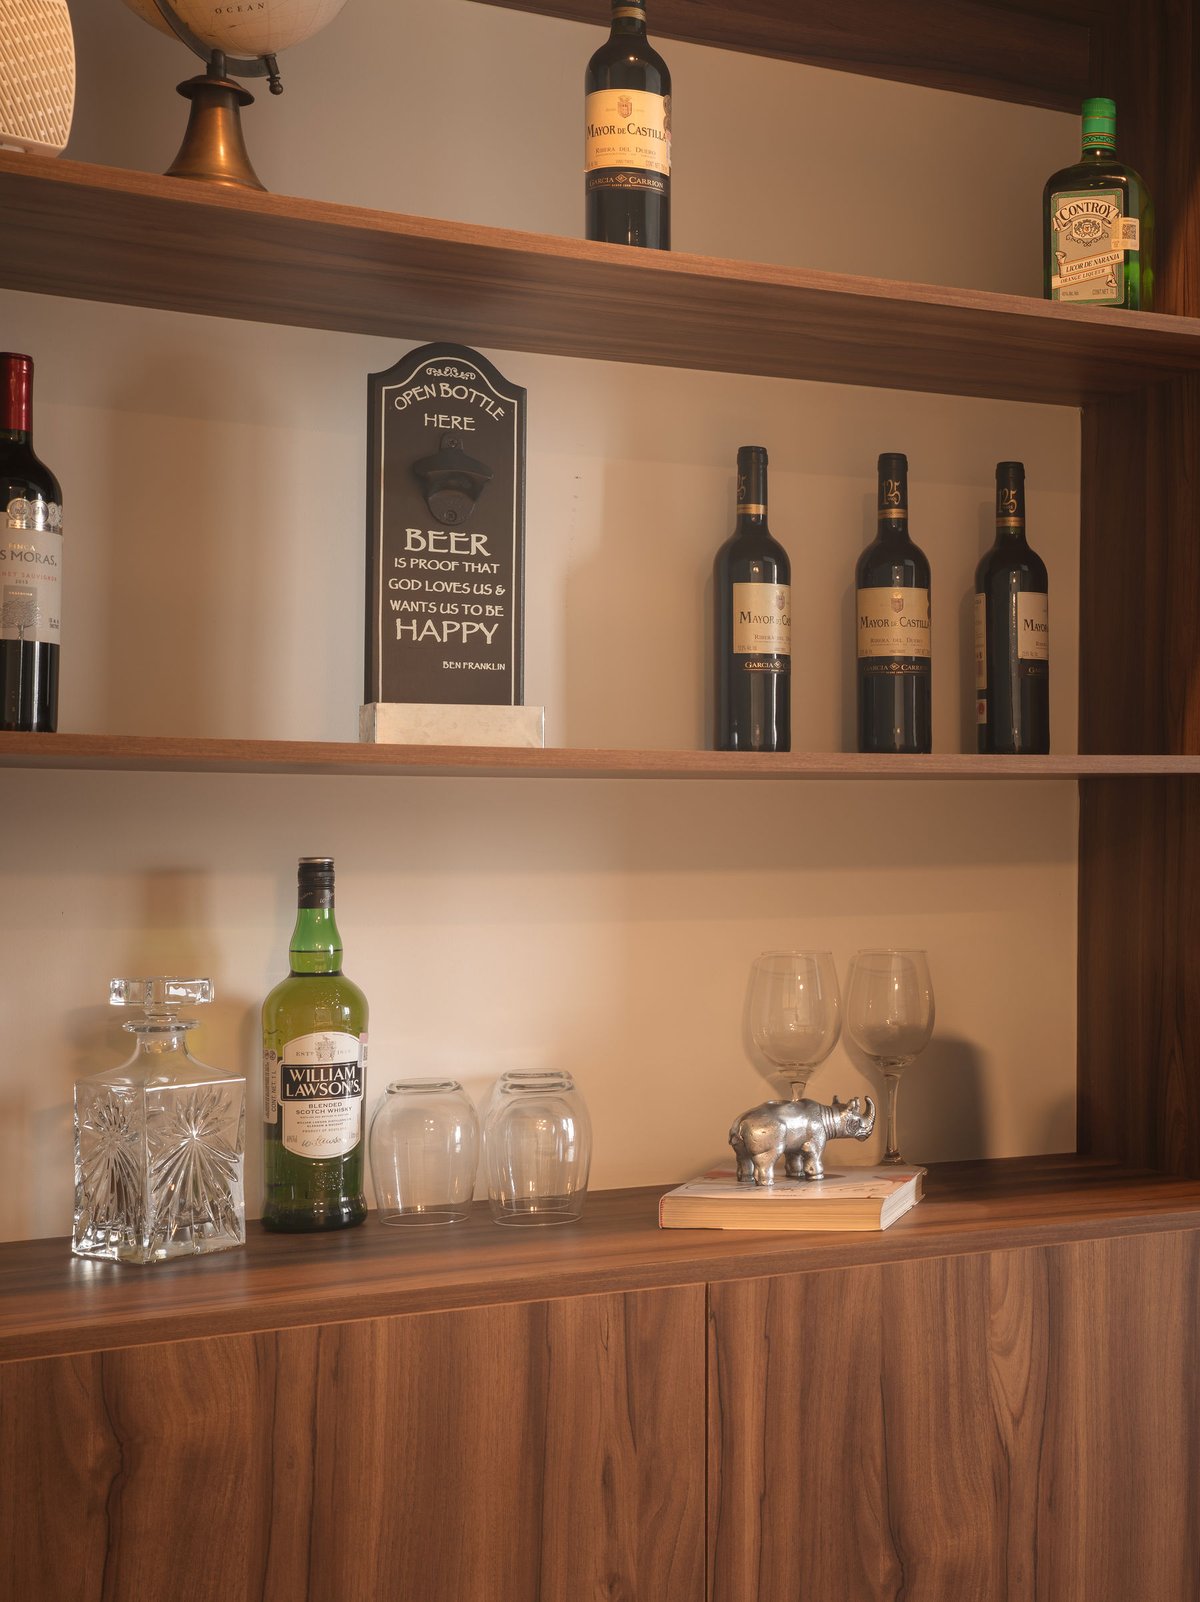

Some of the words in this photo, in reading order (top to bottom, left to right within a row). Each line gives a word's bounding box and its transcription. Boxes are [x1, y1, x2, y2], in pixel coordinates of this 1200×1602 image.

[214, 2, 265, 15] OCEAN
[587, 123, 616, 140] MAYOR
[617, 127, 627, 135] DE
[626, 122, 667, 143] CASTILLA
[589, 177, 614, 187] GARCIA
[628, 176, 664, 189] CARRION
[1059, 201, 1116, 220] CONTROY
[1065, 262, 1084, 273] LICOR
[1084, 260, 1093, 268] DE
[1060, 274, 1081, 284] ORANGE
[394, 383, 437, 410] OPEN
[439, 382, 505, 421] BOTTLE
[424, 413, 476, 431] HERE
[8, 543, 36, 552] FINCA
[404, 528, 492, 557] BEER
[394, 557, 407, 569] IS
[410, 558, 460, 572] PROOF
[462, 561, 501, 574] THAT
[388, 578, 422, 591] GOD
[425, 580, 471, 595] LOVES
[473, 583, 493, 596] US
[495, 584, 506, 596] &
[389, 599, 437, 614] WANTS
[440, 602, 459, 615] US
[461, 603, 483, 616] TO
[485, 605, 504, 617] BE
[739, 611, 775, 624] MAYOR
[860, 616, 890, 629] MAYOR
[395, 617, 500, 645] HAPPY
[442, 660, 461, 670] BEN
[462, 661, 506, 671] FRANKLIN
[744, 661, 774, 669] GARCIA
[289, 1065, 356, 1082] WILLIAM
[327, 1106, 353, 1114] WHISKY
